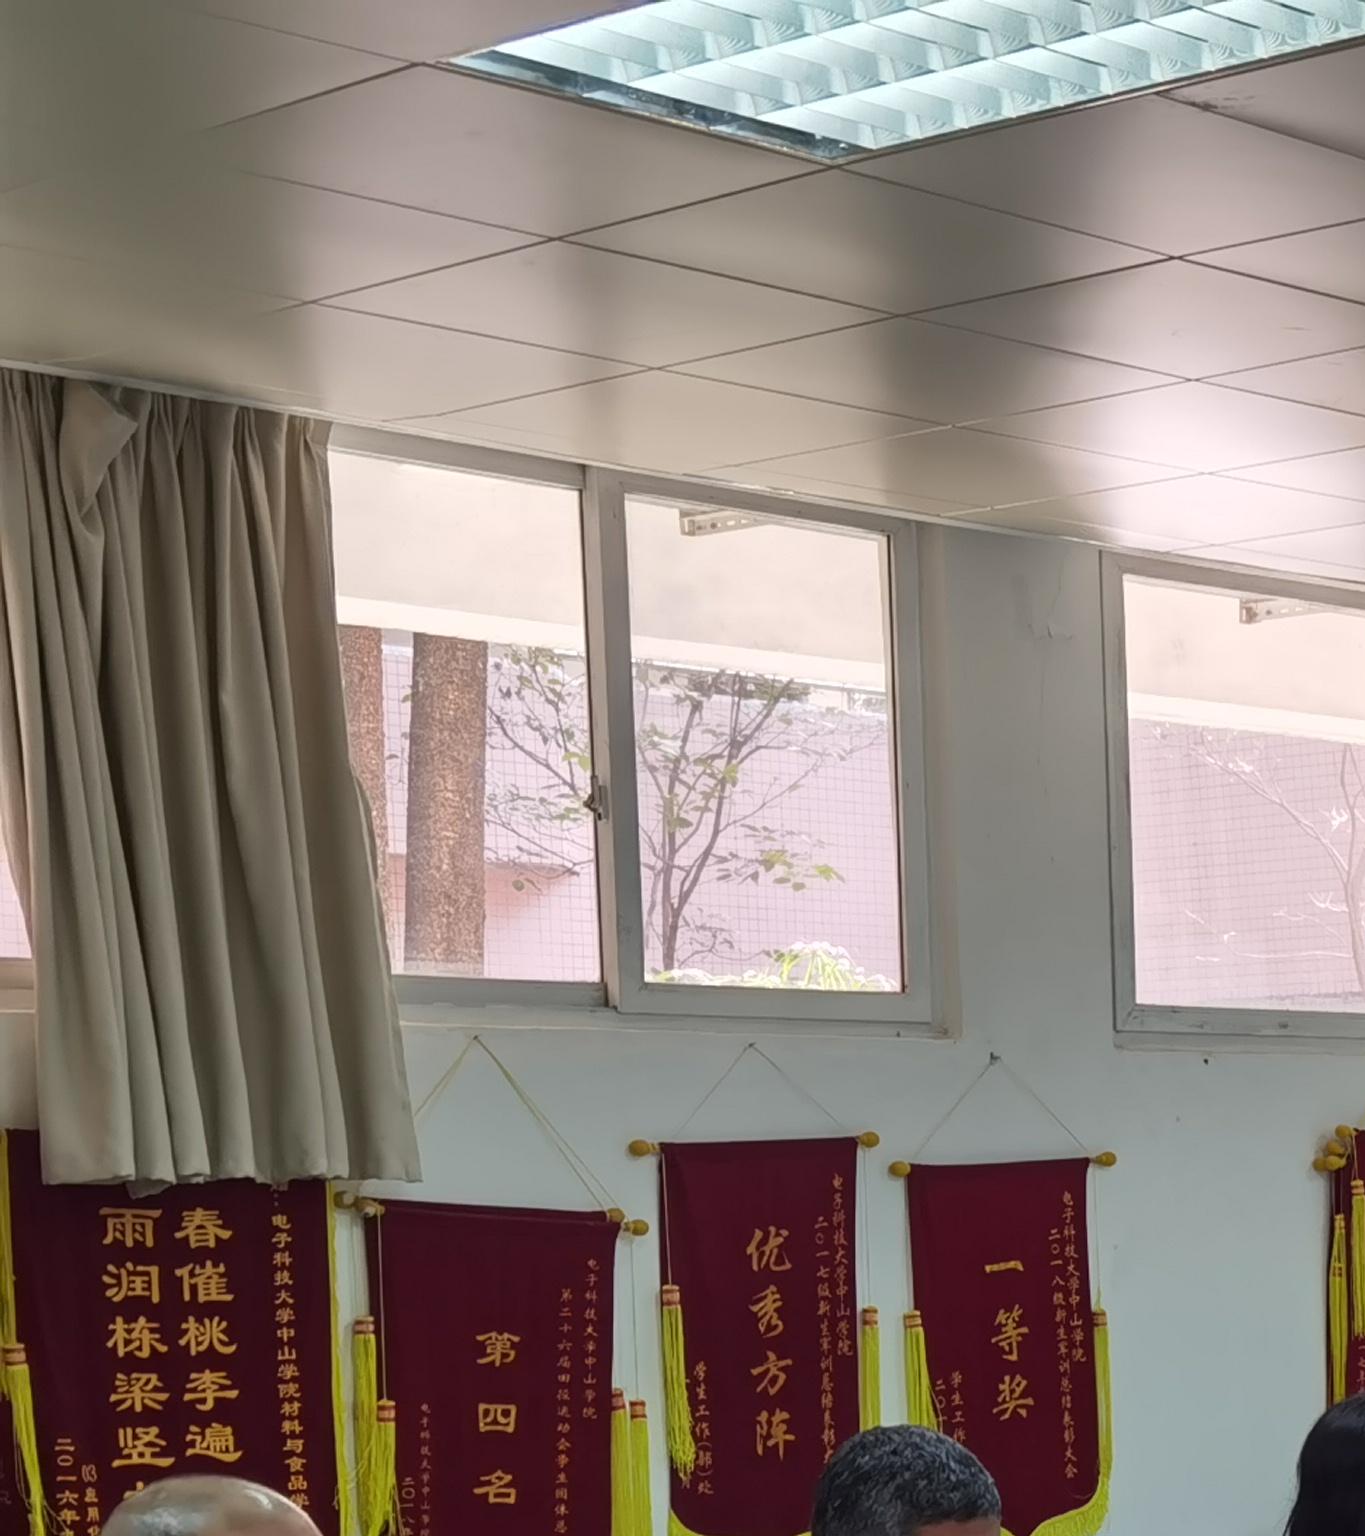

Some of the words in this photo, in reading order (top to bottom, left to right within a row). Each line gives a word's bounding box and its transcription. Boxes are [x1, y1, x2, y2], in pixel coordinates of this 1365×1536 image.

[99, 1206, 176, 1501] 雨润栋梁竖
[173, 1206, 243, 1464] 春催桃李遍
[472, 1330, 521, 1506] 第四名
[745, 1225, 797, 1461] 优秀方阵
[984, 1259, 1036, 1422] 一等奖
